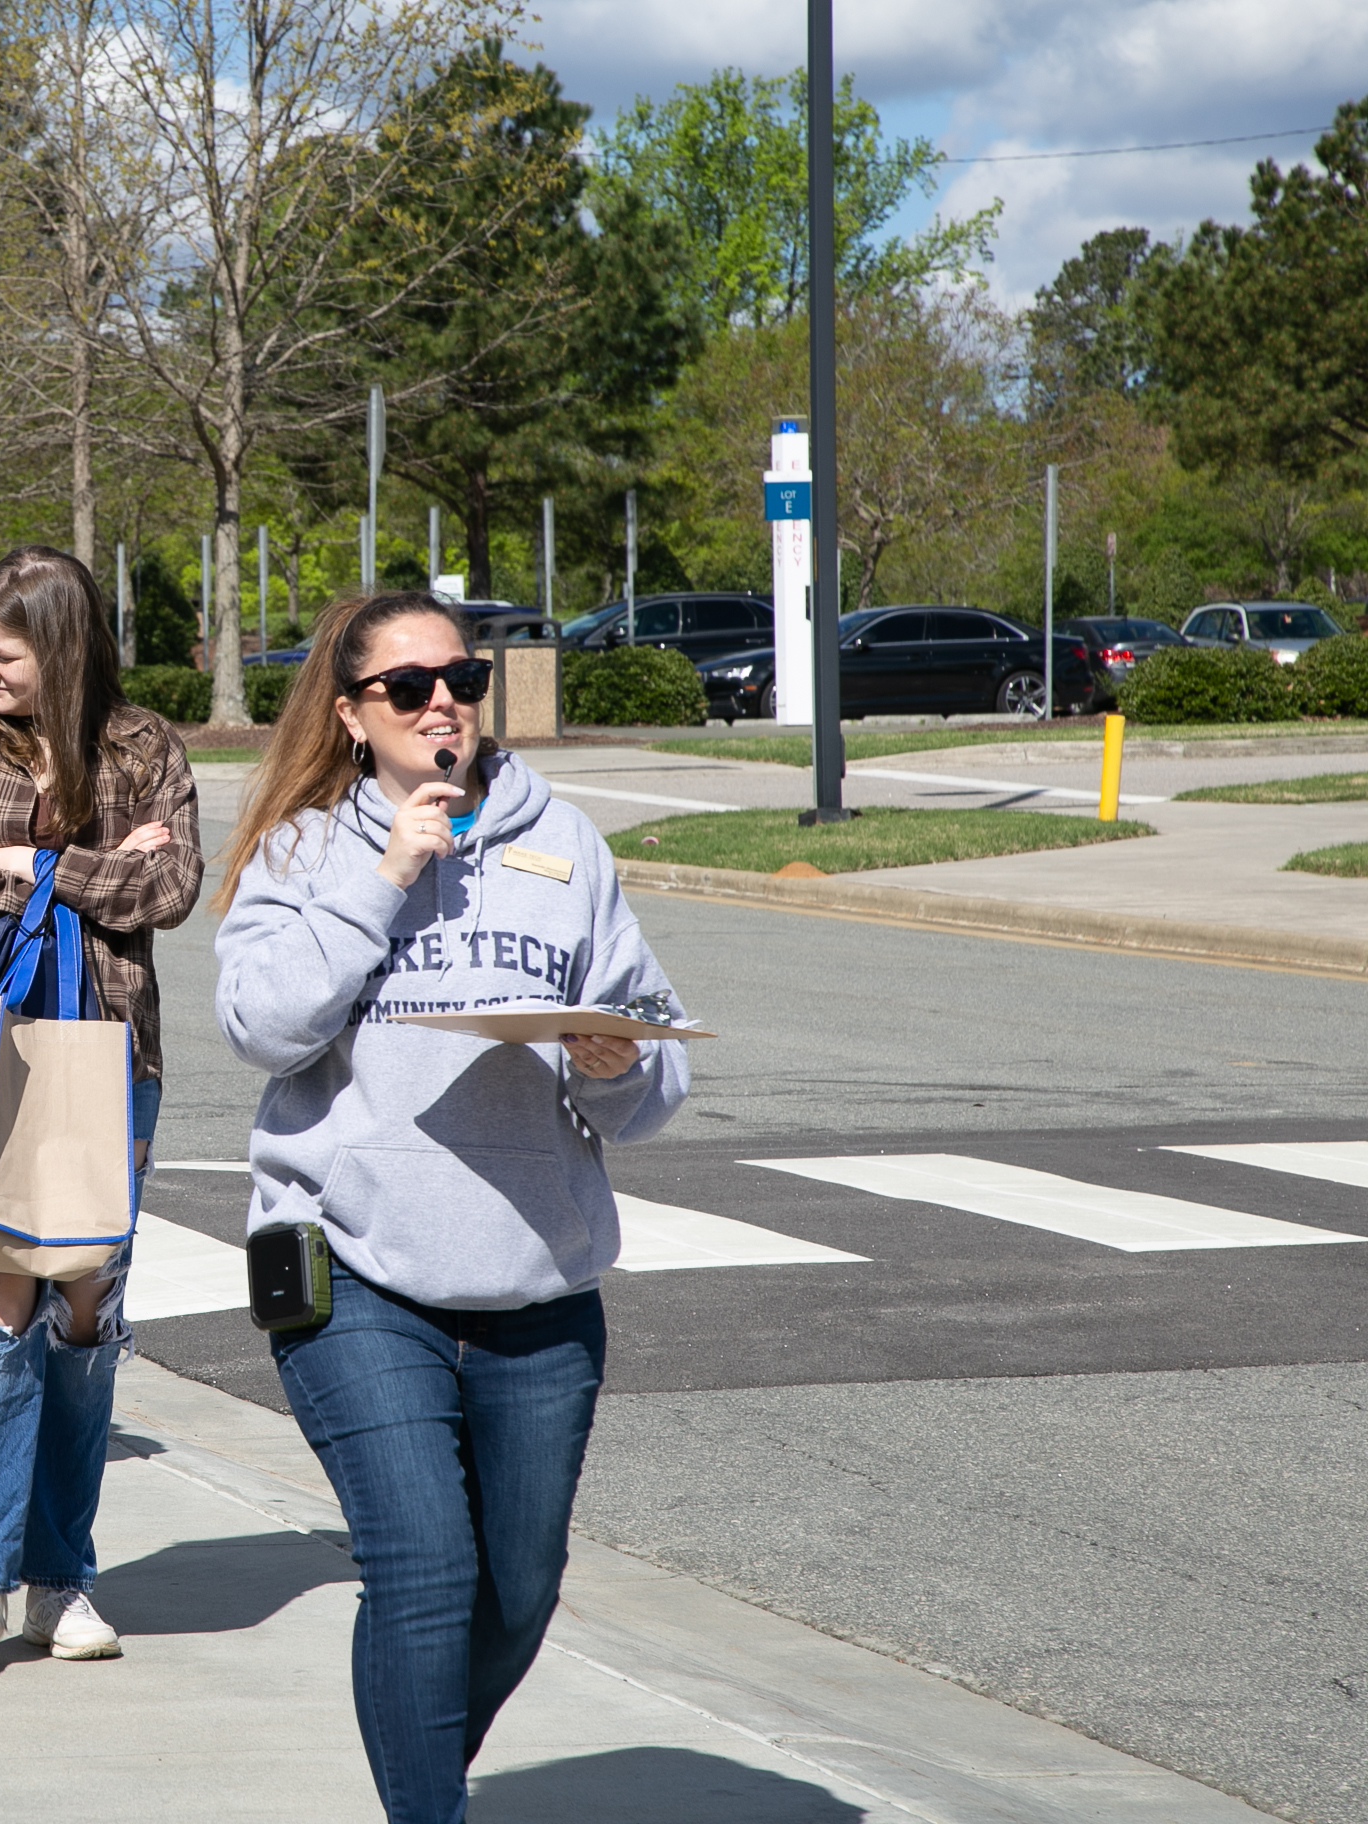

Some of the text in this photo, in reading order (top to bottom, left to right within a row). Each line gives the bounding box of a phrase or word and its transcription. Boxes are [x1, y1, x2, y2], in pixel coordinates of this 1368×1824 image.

[780, 490, 796, 500] LOT
[785, 501, 792, 514] E
[365, 931, 571, 994] AKE TECH
